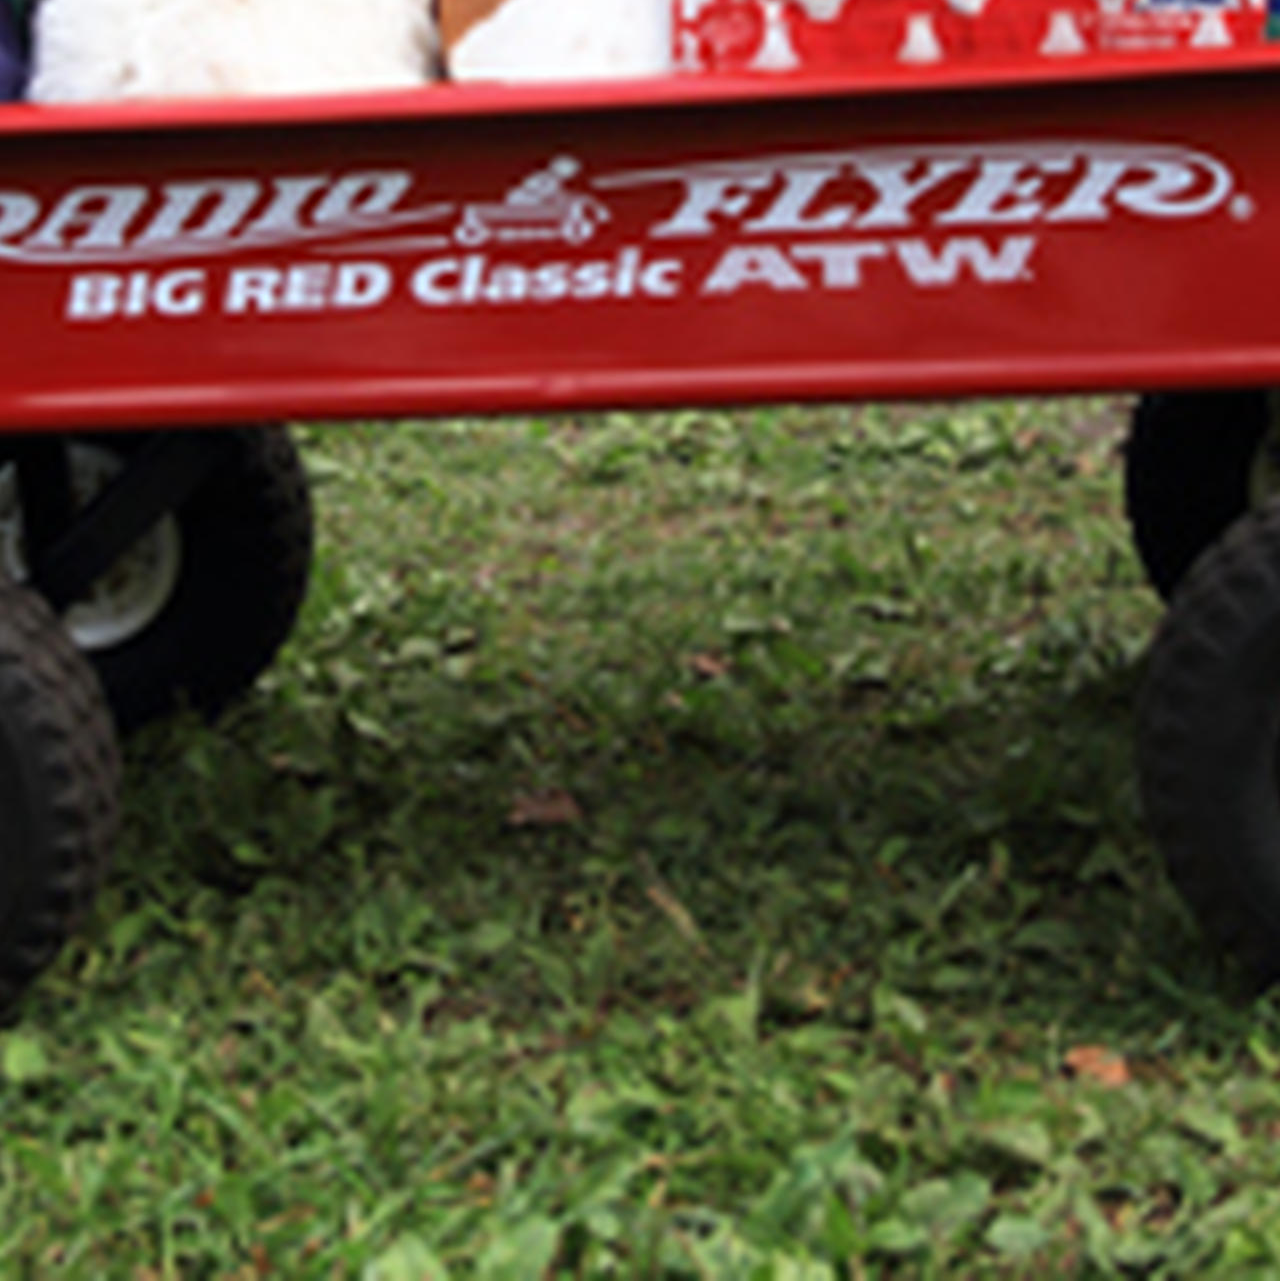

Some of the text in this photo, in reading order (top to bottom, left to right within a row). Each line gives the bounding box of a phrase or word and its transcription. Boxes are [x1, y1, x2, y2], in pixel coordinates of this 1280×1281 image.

[651, 142, 1232, 237] FLYER
[66, 236, 1036, 320] BIG RED Classic ATW
